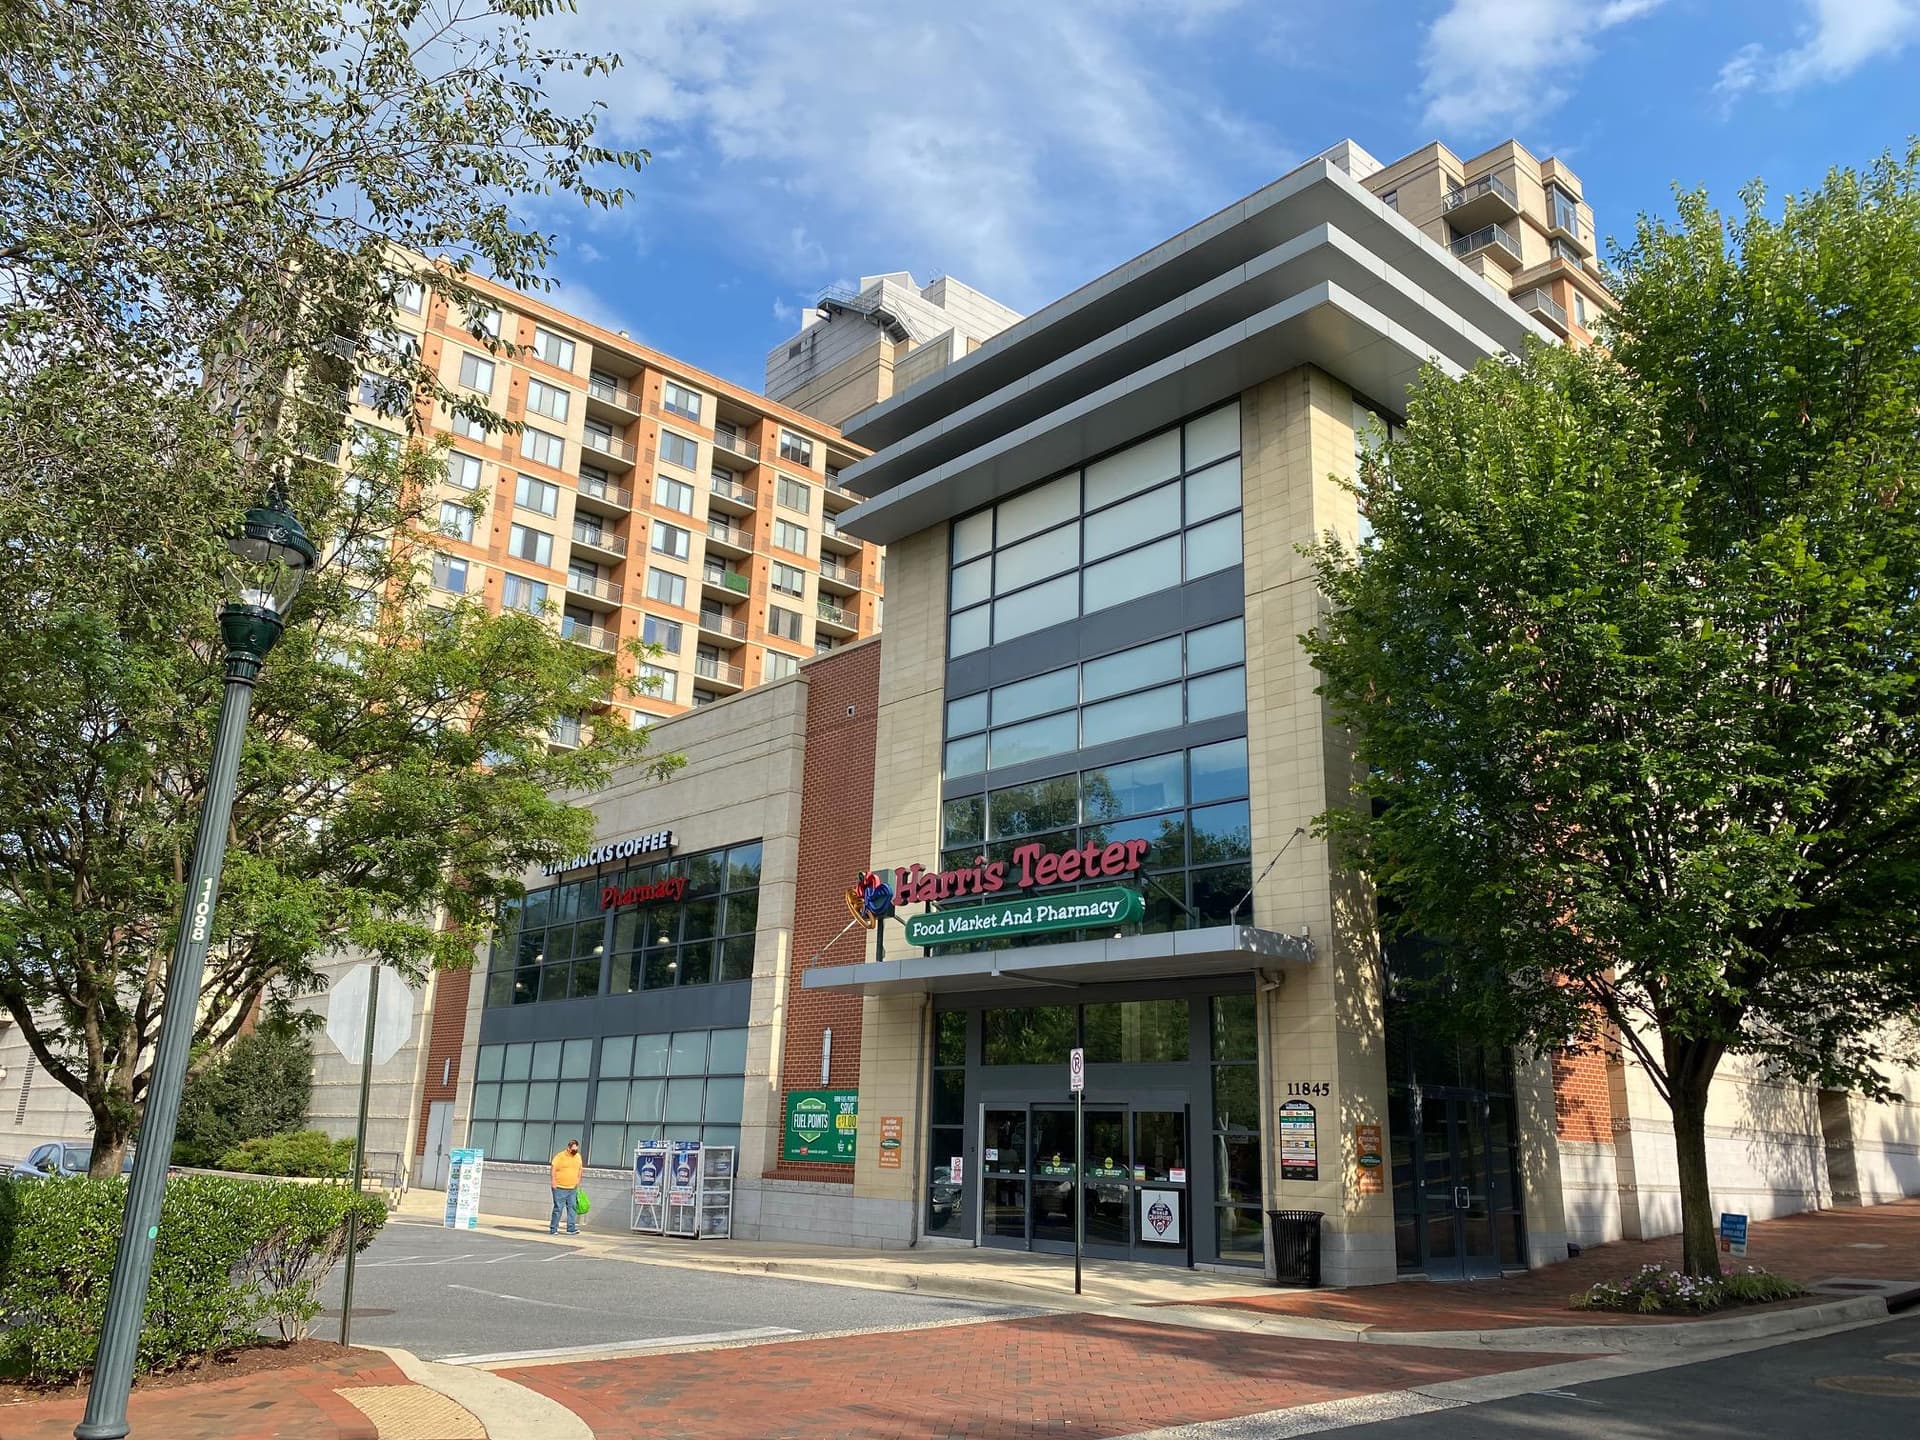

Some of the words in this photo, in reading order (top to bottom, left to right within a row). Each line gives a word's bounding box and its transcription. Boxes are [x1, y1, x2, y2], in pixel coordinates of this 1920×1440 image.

[615, 830, 670, 859] COFFEE
[891, 855, 1004, 907] Harris
[1013, 838, 1149, 888] Teeter
[191, 877, 213, 941] 11098
[600, 877, 687, 911] Pharmacy
[912, 916, 944, 937] Food
[948, 913, 998, 934] Market
[1000, 908, 1033, 926] And
[1036, 899, 1121, 923] Pharmacy
[1287, 1082, 1330, 1097] 11845
[793, 1113, 806, 1129] FUEL
[807, 1113, 829, 1129] POINTS
